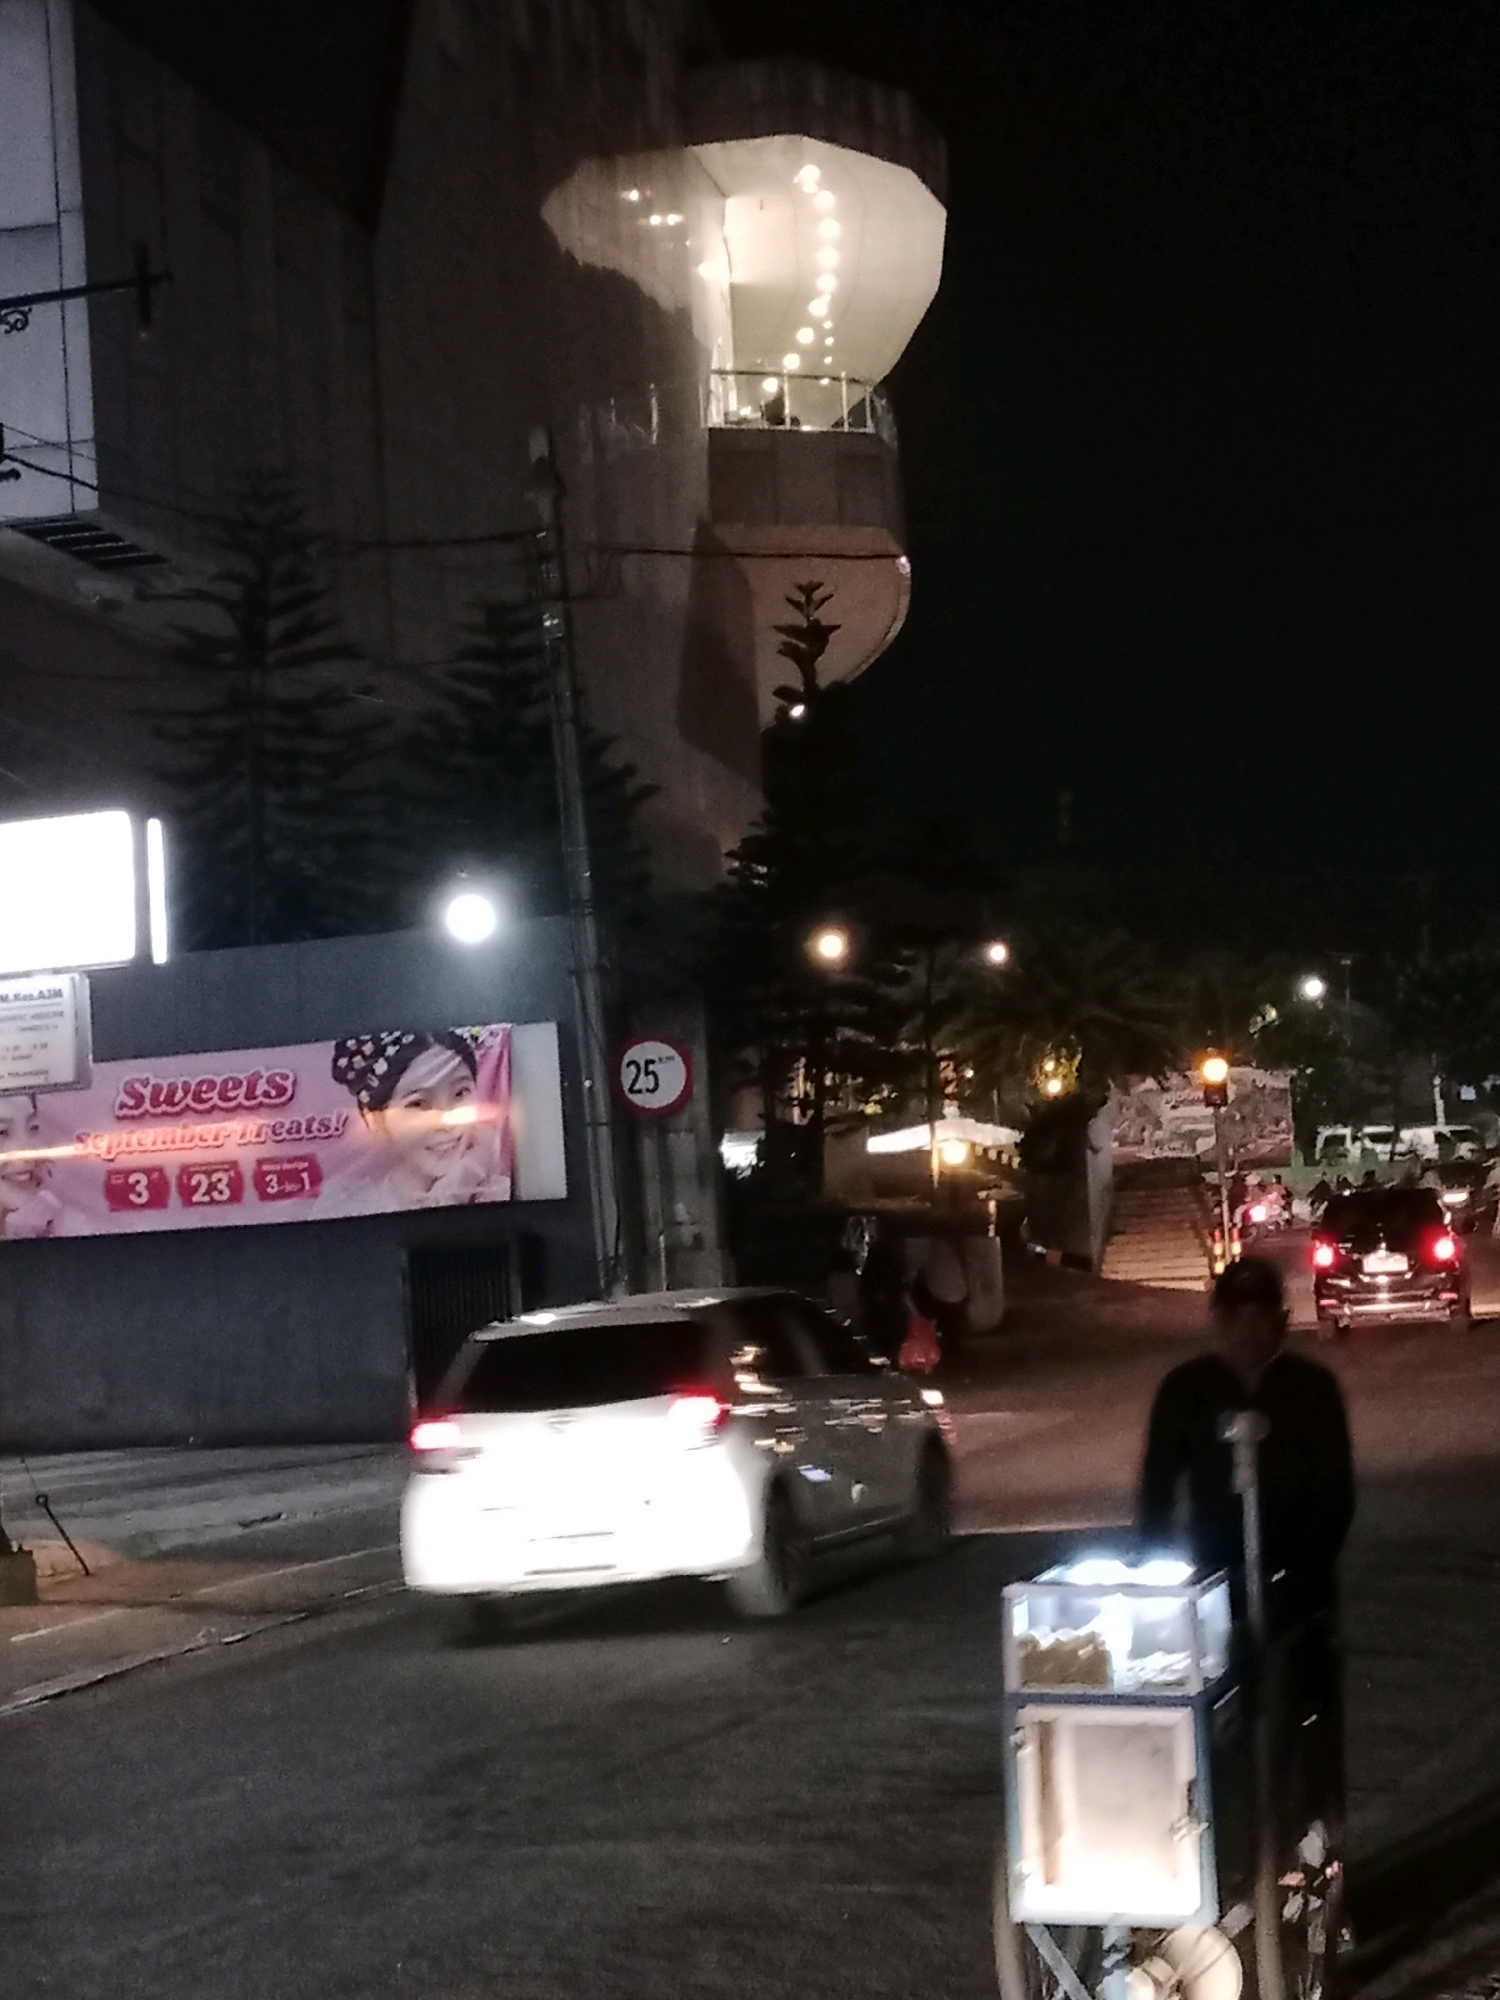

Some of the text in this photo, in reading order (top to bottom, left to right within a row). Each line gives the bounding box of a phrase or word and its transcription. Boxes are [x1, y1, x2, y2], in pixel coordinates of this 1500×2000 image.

[116, 1067, 296, 1118] Sweets
[625, 1059, 660, 1094] 25
[75, 1111, 349, 1160] September Treats!
[127, 1172, 150, 1205] 3
[191, 1172, 231, 1204] 23
